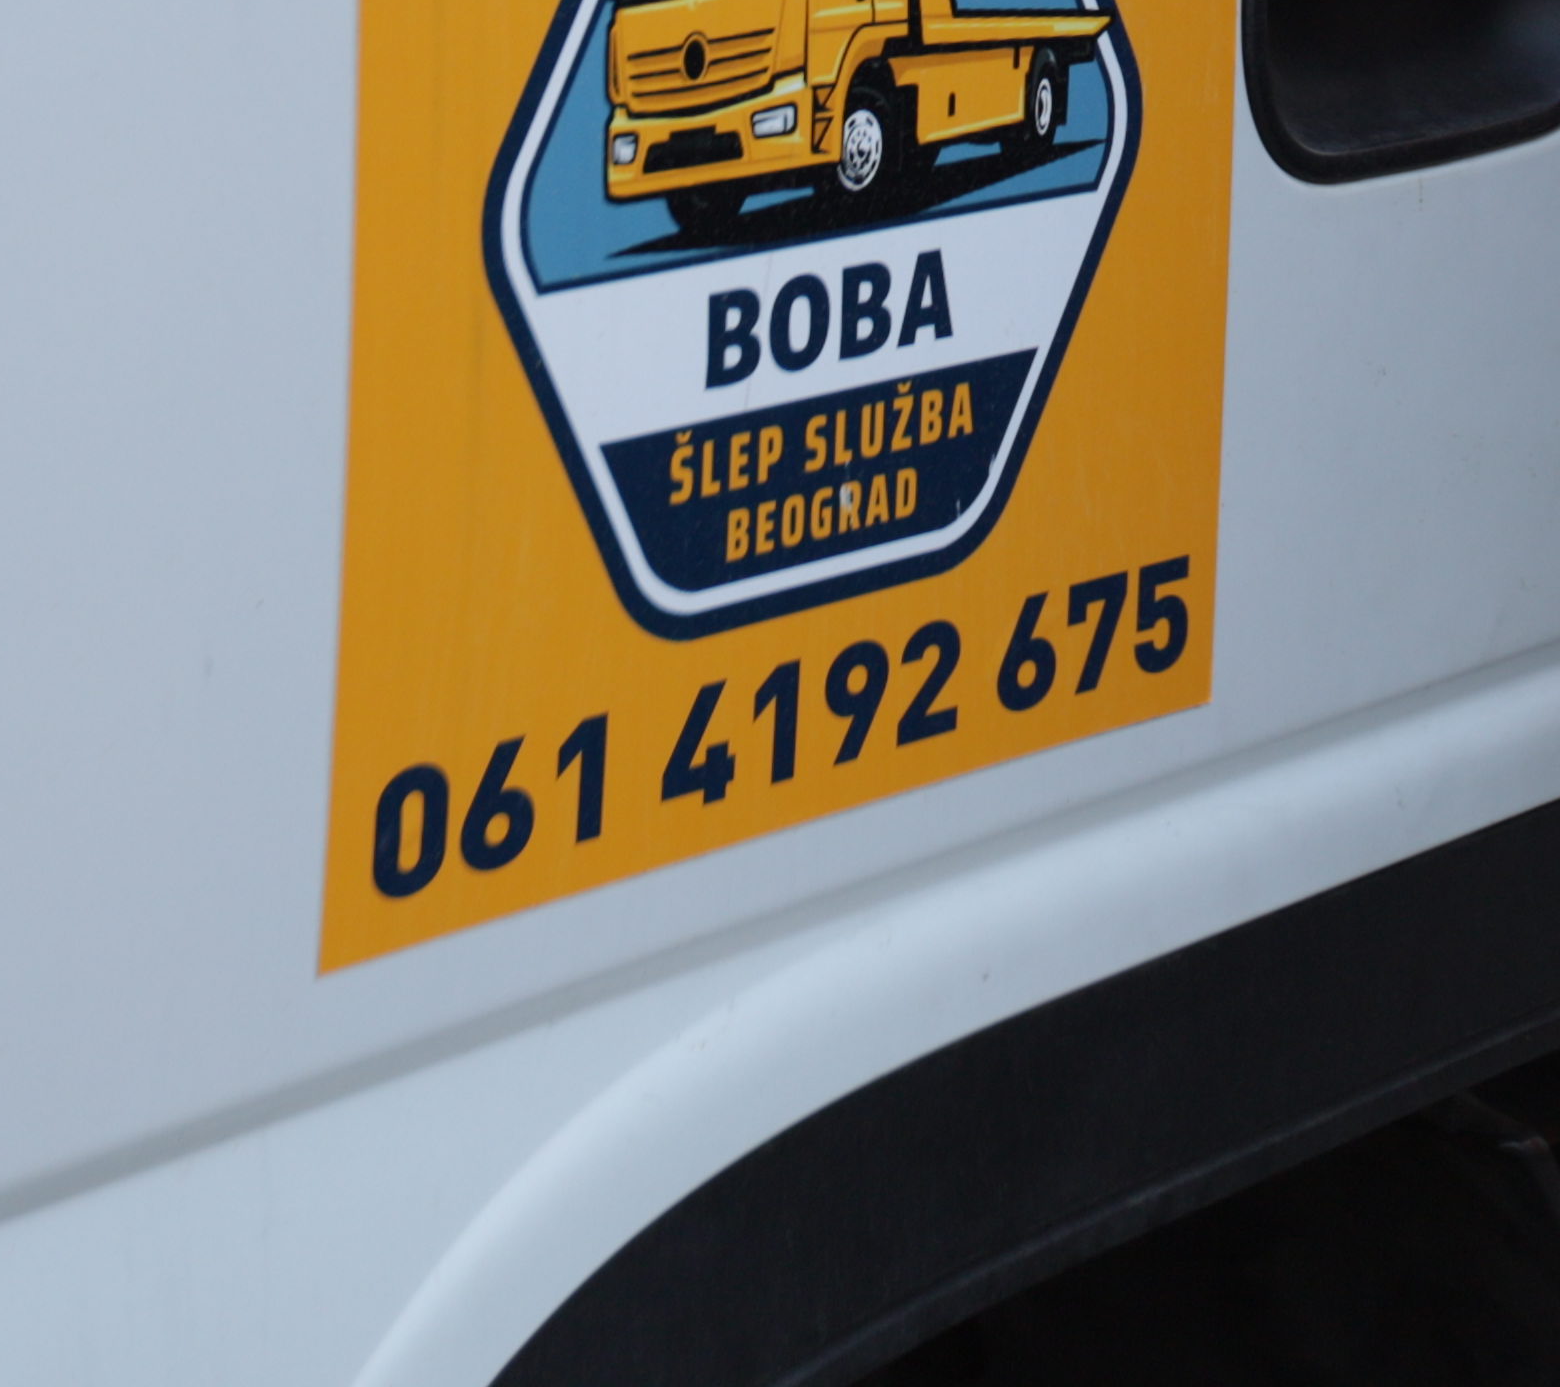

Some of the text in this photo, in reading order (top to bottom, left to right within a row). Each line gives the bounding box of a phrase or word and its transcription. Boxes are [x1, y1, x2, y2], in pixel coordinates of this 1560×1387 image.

[704, 248, 954, 391] BOBA
[669, 381, 974, 506] ŠLEP SLUŽBA
[725, 467, 918, 563] BEOGRAD
[371, 553, 1192, 900] 061 4192 675
